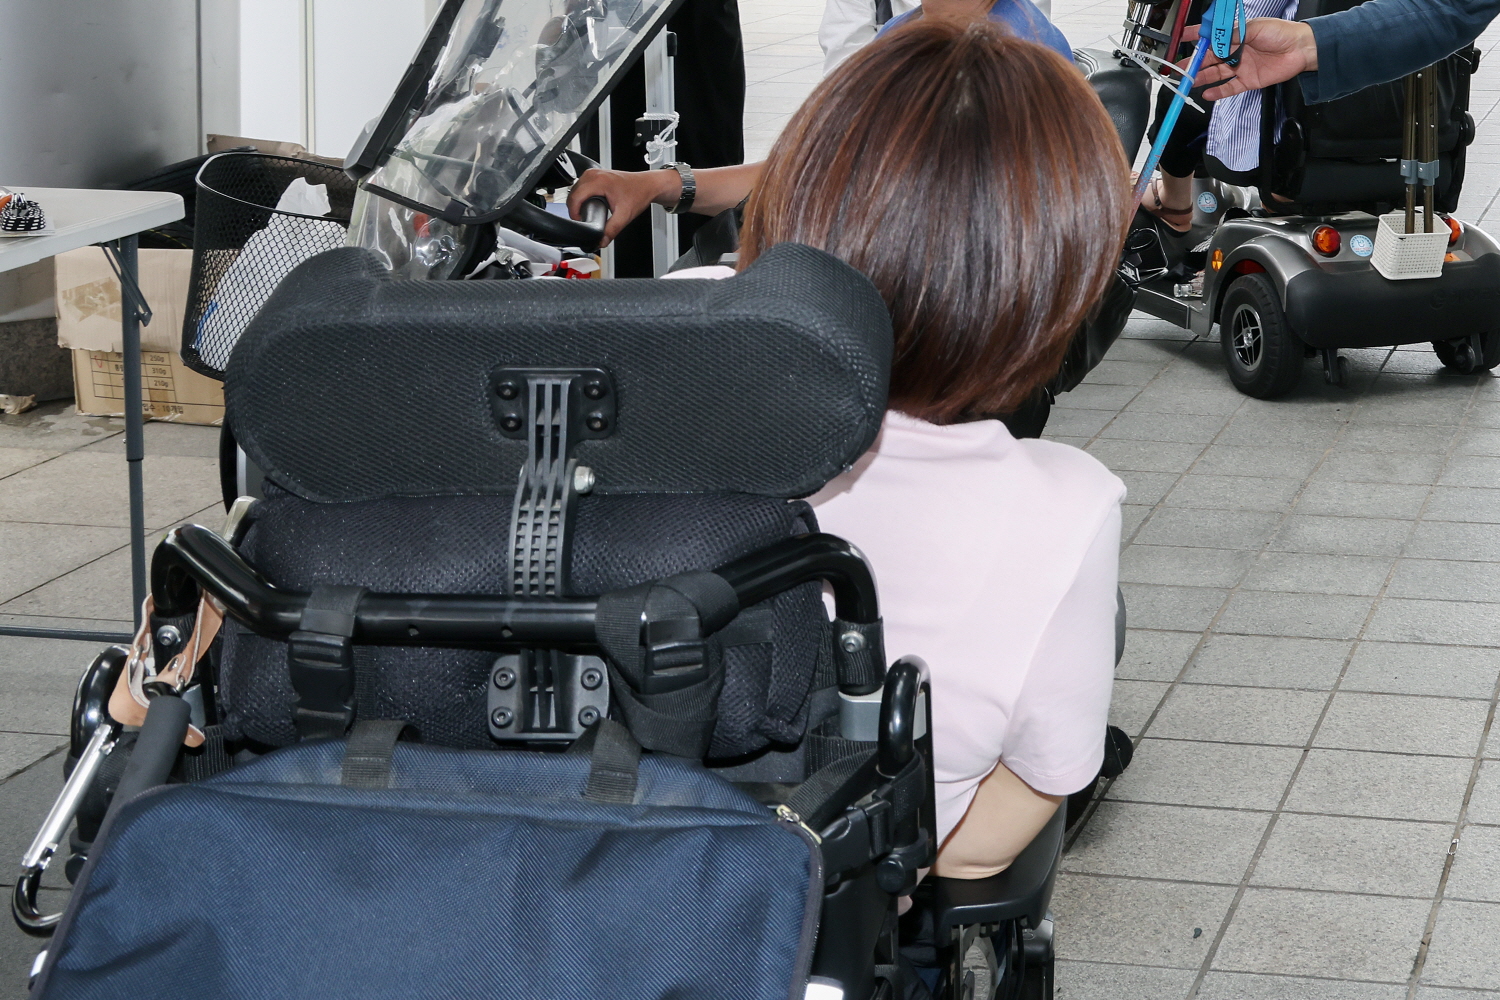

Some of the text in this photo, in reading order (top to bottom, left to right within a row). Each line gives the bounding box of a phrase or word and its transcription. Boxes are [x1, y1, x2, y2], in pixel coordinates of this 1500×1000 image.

[150, 354, 164, 363] 250g
[152, 367, 166, 375] 310g
[154, 379, 168, 388] 210g
